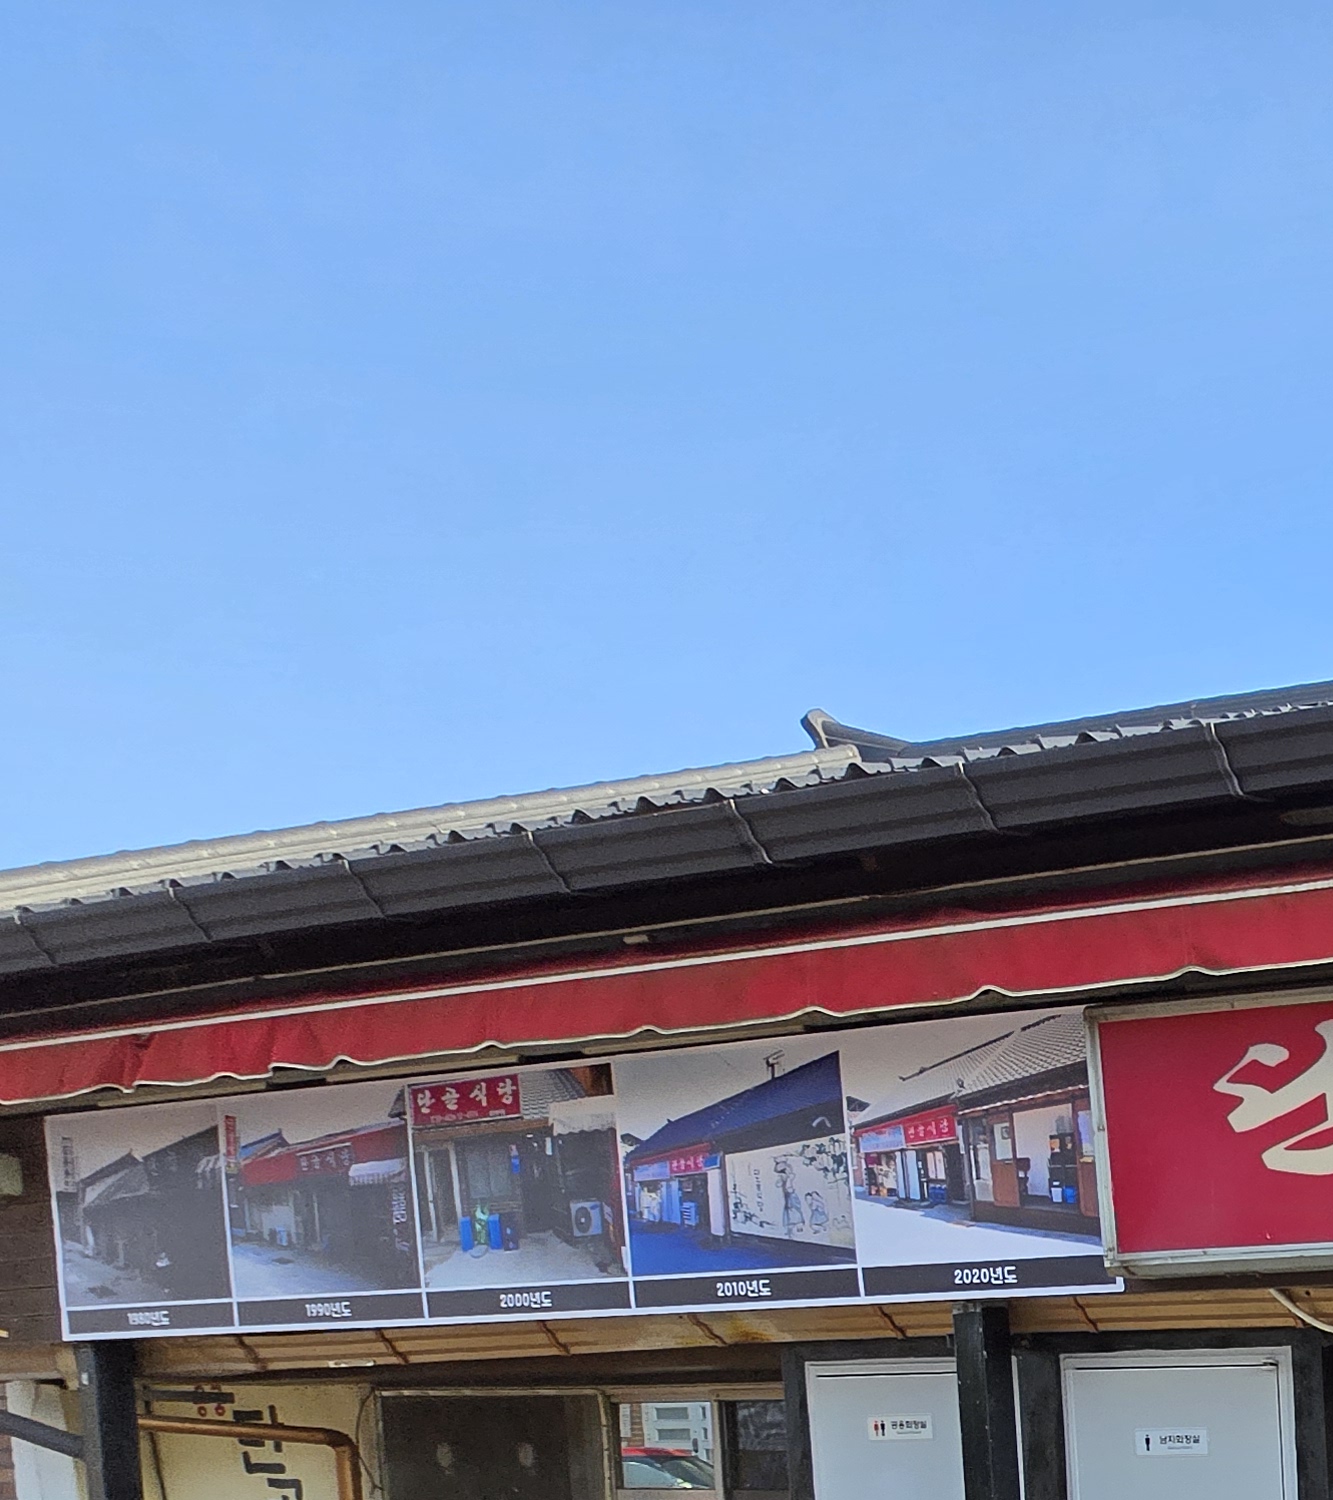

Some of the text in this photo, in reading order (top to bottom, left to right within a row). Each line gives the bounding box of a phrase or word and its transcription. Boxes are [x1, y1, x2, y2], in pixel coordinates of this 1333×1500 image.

[954, 1266, 1018, 1284] 2020년도
[716, 1279, 772, 1297] 2010년도
[500, 1291, 552, 1309] 2000년도
[305, 1302, 352, 1317] 1990년도
[1160, 1435, 1200, 1444] 남자화장실
